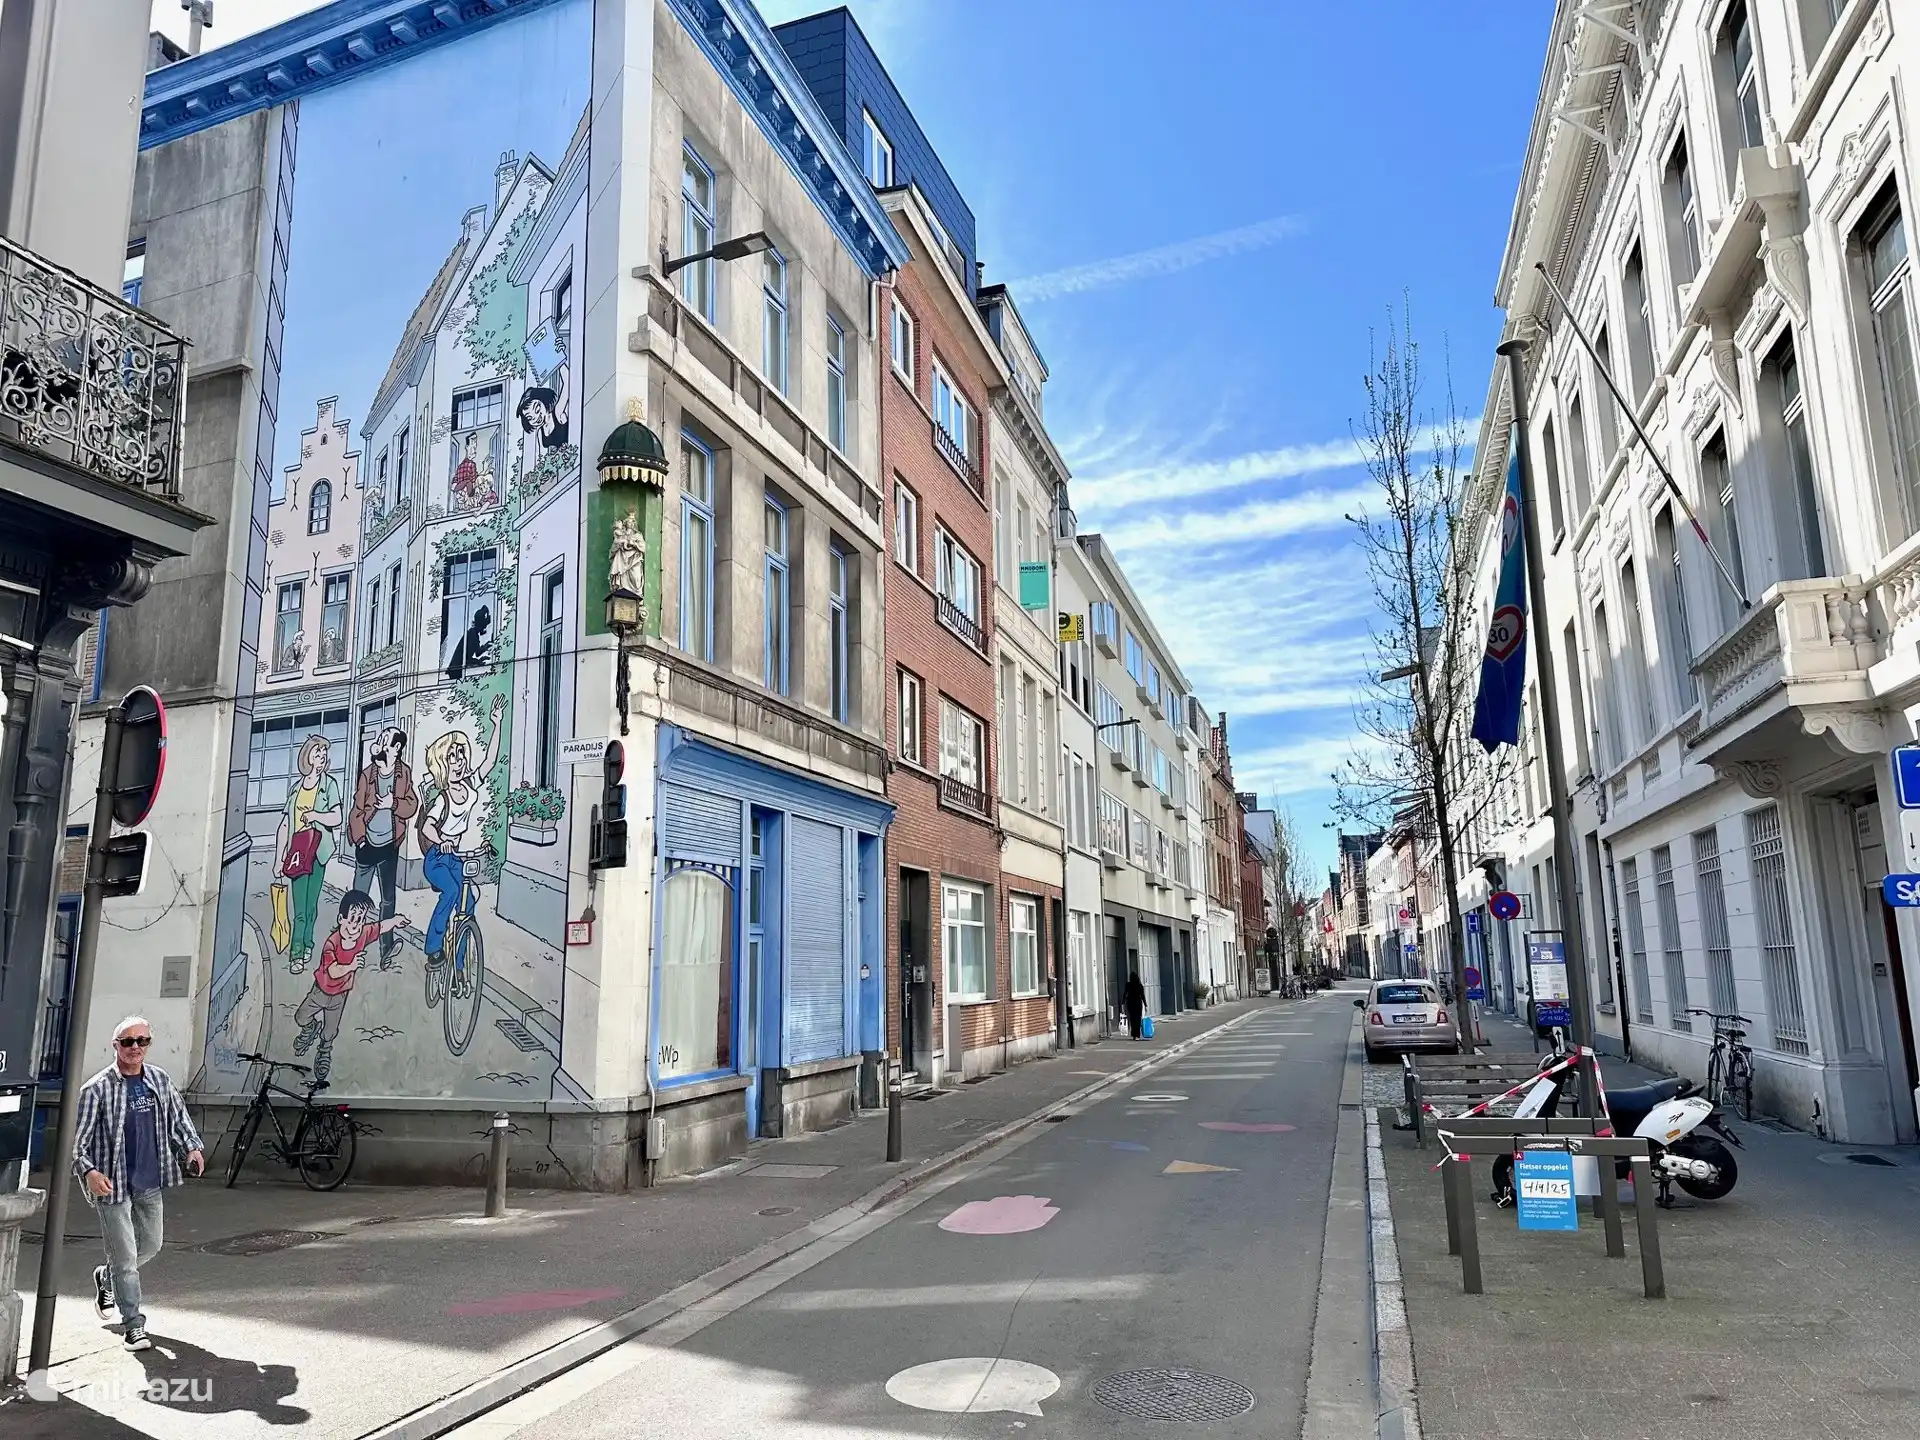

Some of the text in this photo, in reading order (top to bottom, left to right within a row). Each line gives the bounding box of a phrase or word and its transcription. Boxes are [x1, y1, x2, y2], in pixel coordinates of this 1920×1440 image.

[1489, 627, 1509, 643] 30
[563, 741, 604, 754] PARADIJS
[583, 752, 603, 760] STRAAT
[287, 850, 300, 871] A
[1519, 1163, 1569, 1172] Fietser opgelet
